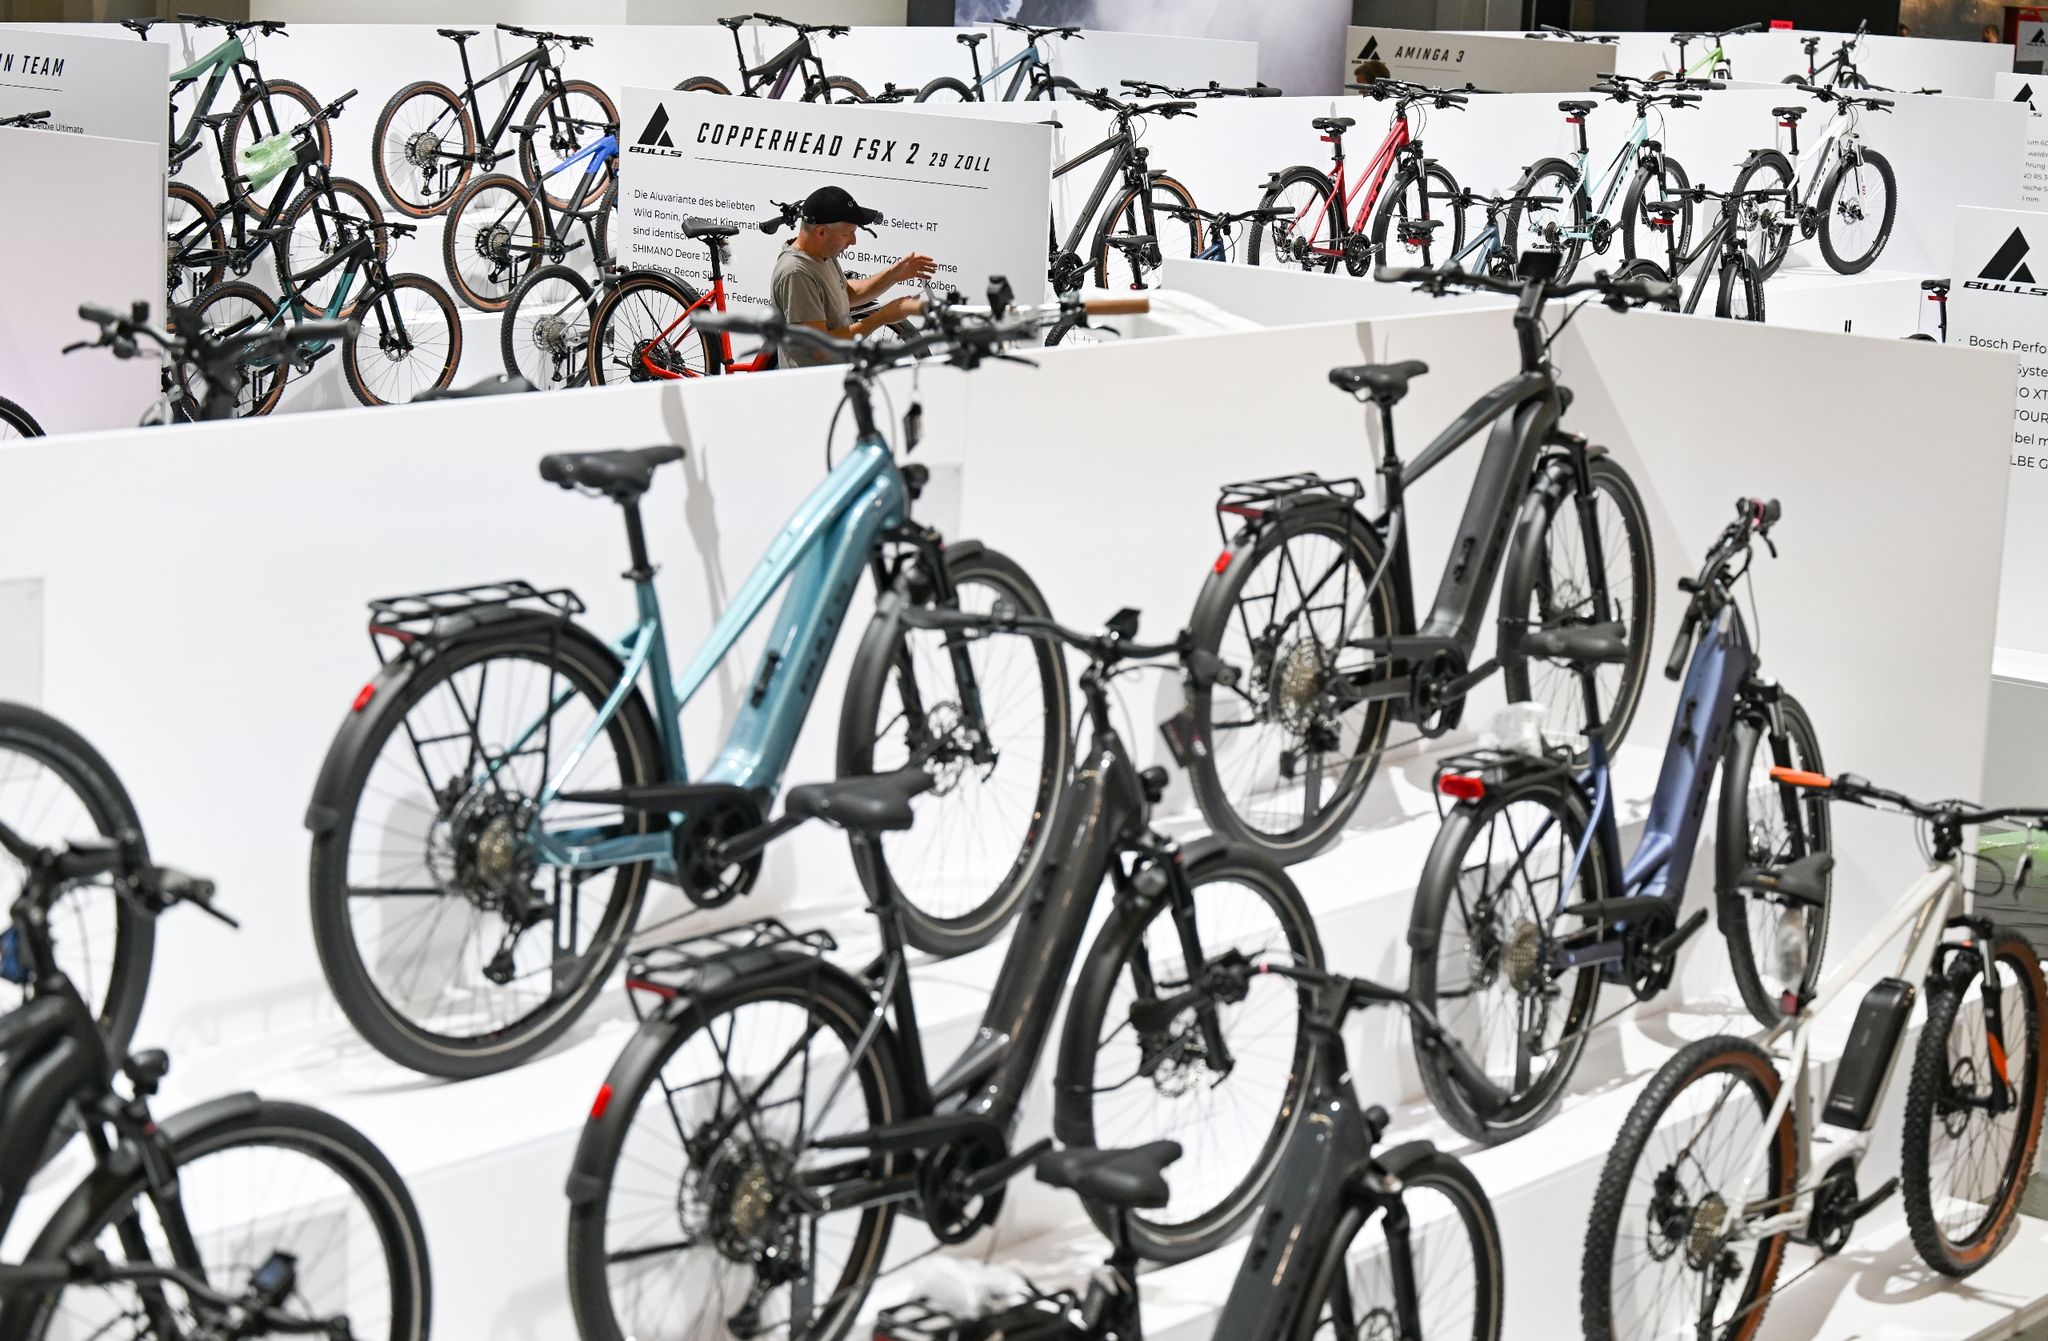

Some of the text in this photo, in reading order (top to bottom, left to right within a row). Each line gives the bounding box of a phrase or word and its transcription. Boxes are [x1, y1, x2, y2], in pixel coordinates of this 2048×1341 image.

[1395, 46, 1465, 63] AMINGA 3
[0, 53, 65, 77] N TEAM
[55, 123, 84, 134] Ultimate
[628, 146, 683, 158] BULLS
[697, 122, 990, 172] COPPERHEAD FSX 2 29 ZOLL
[634, 189, 756, 212] Die Aluvariante des beliebten
[633, 208, 652, 218] Wild
[654, 210, 681, 222] Ronin,
[633, 226, 650, 237] sind
[891, 218, 924, 231] Select+
[926, 222, 938, 232] RT
[632, 243, 673, 257] SHIMANO
[675, 249, 700, 260] Deore
[674, 267, 700, 278] Recon
[727, 273, 738, 284] RL
[925, 279, 956, 293] Kolben
[1963, 281, 2048, 297] BULLS
[1969, 335, 2008, 350] Bosch
